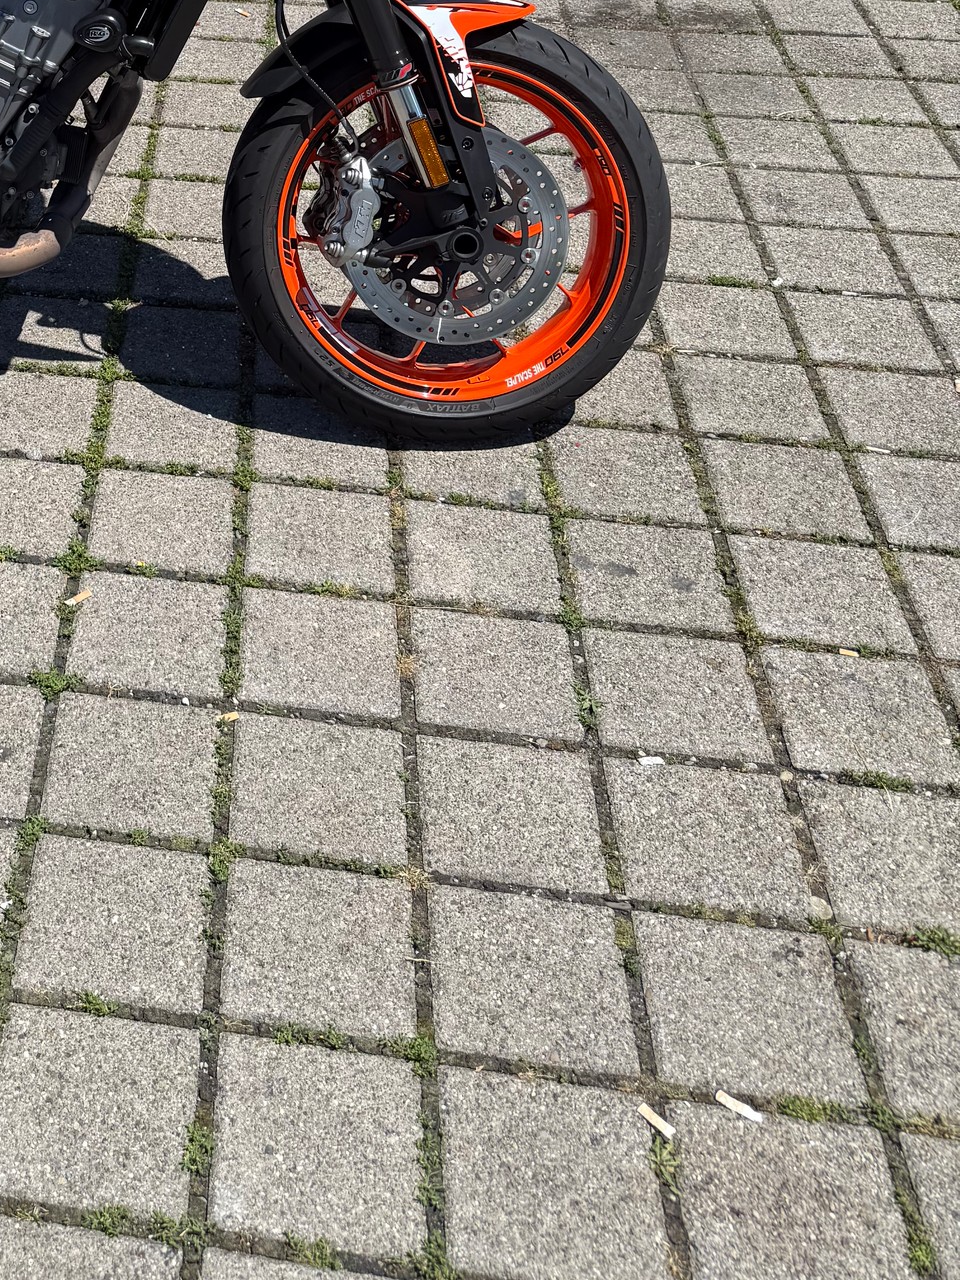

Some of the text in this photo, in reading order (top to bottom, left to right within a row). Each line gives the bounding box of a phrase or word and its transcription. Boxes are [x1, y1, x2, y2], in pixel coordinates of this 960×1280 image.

[353, 92, 365, 105] THE
[545, 346, 570, 369] 790
[532, 361, 546, 376] THE
[505, 368, 533, 388] SCALPEL
[426, 403, 481, 413] BATTLAX
